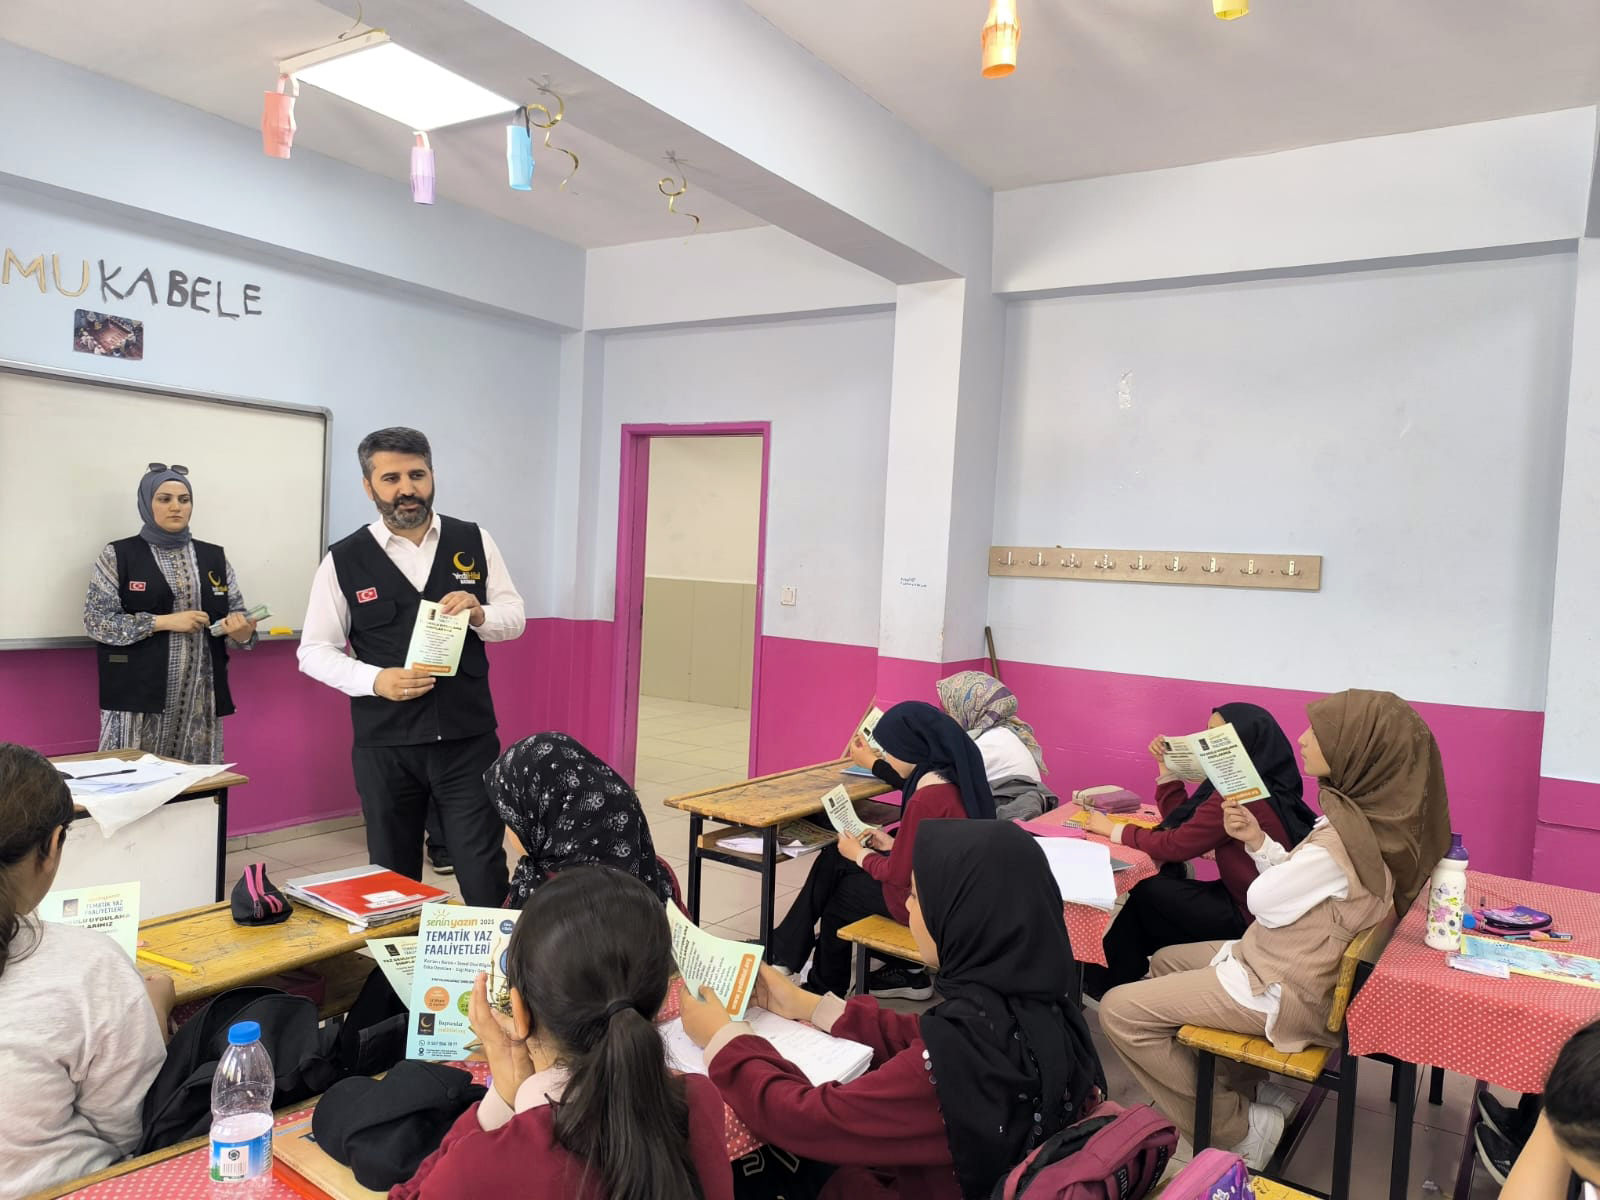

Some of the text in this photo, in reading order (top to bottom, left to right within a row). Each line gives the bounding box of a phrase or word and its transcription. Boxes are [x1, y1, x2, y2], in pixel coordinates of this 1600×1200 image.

[2, 248, 262, 320] MUKABELE
[426, 928, 494, 942] TEMATİK YAZ
[424, 942, 491, 956] FAALİYETLERİ
